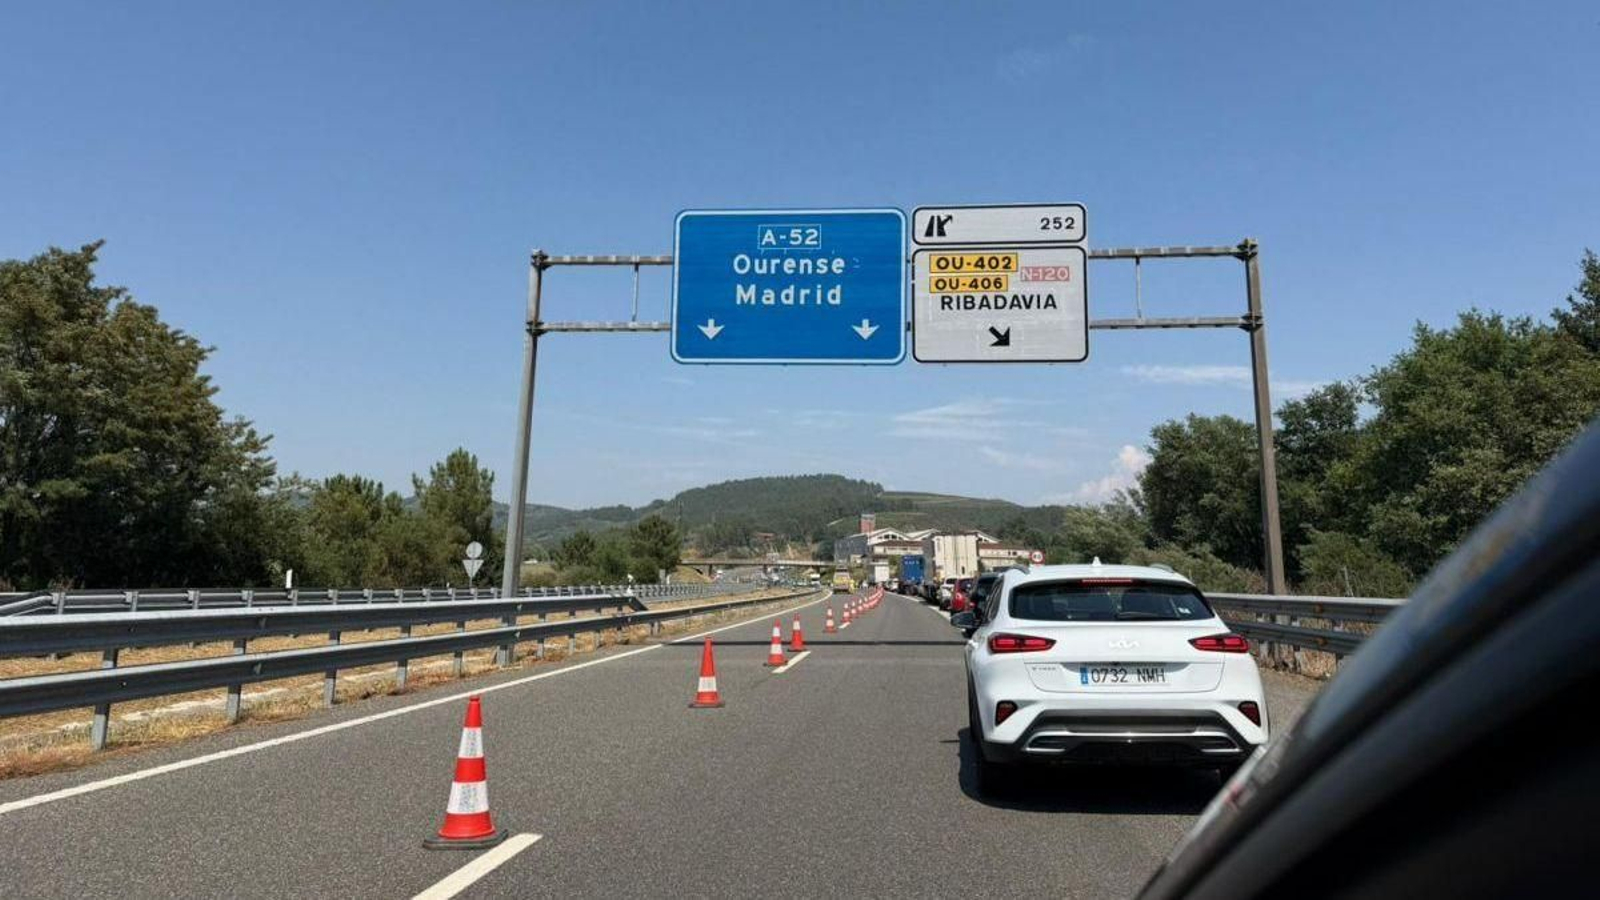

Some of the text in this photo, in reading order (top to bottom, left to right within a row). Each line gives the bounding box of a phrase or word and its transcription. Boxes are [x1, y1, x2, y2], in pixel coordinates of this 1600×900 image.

[1040, 216, 1076, 231] 252
[761, 228, 819, 246] A-52
[733, 253, 846, 275] Ourense
[935, 255, 1013, 271] OU-402
[1020, 267, 1070, 281] N-120
[934, 277, 1004, 291] OU-406
[735, 283, 842, 306] Madrid
[940, 294, 1058, 311] RIBADAVIA
[1090, 667, 1129, 684] 0732
[1136, 667, 1167, 683] NMH
